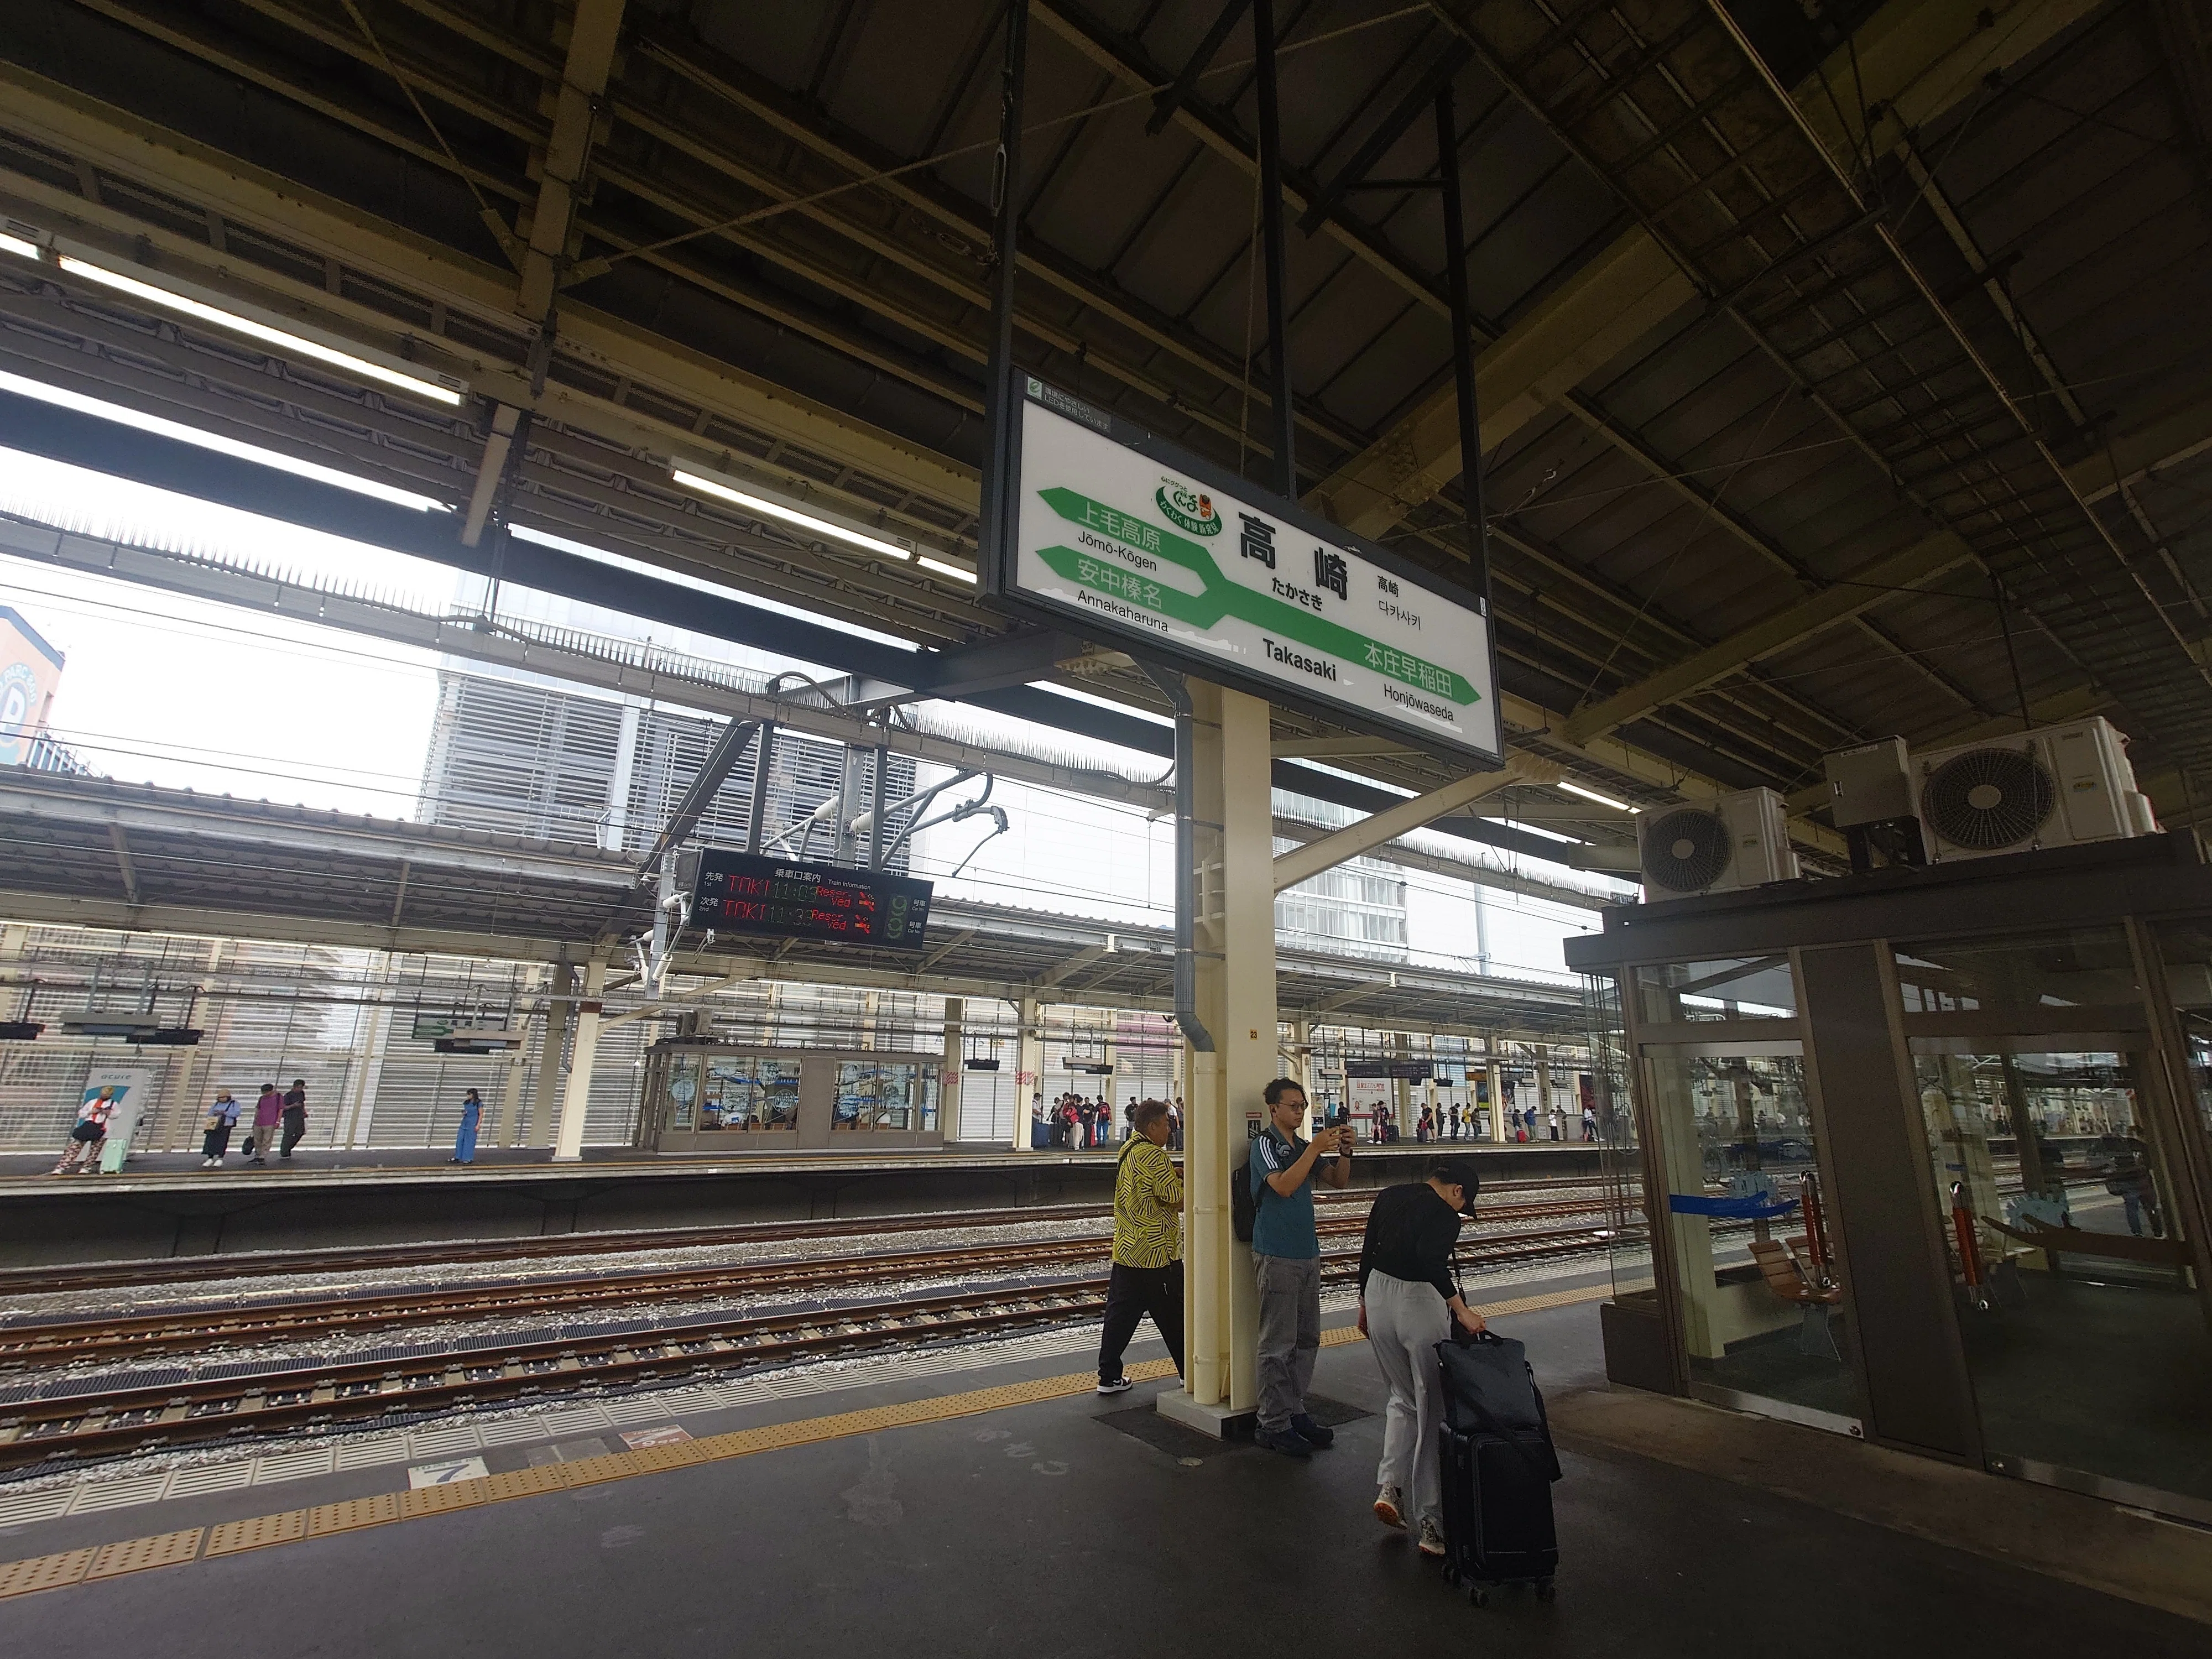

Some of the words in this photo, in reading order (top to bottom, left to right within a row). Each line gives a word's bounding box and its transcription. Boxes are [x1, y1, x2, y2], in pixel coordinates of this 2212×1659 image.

[1045, 387, 1089, 413] 環境にやさしい
[1045, 394, 1110, 429] LEDを使用しています
[1078, 502, 1161, 552] 上毛高原
[1078, 531, 1157, 571] Jōmō-Kōgen
[1238, 512, 1348, 601] 高崎
[1078, 559, 1161, 609] 安中榛名
[1272, 577, 1323, 612] たかさき
[1378, 575, 1399, 598] 高崎
[1078, 590, 1168, 633] Annakaharuna
[1379, 600, 1421, 630] 다카사키
[1262, 638, 1337, 682] Takasaki
[1364, 642, 1452, 698] 本庄早稲田
[1384, 684, 1454, 722] Honjōwaseda
[705, 872, 723, 882] 先発
[775, 868, 821, 883] 乗車口案内
[842, 881, 871, 890] Information
[700, 896, 718, 906] 次発
